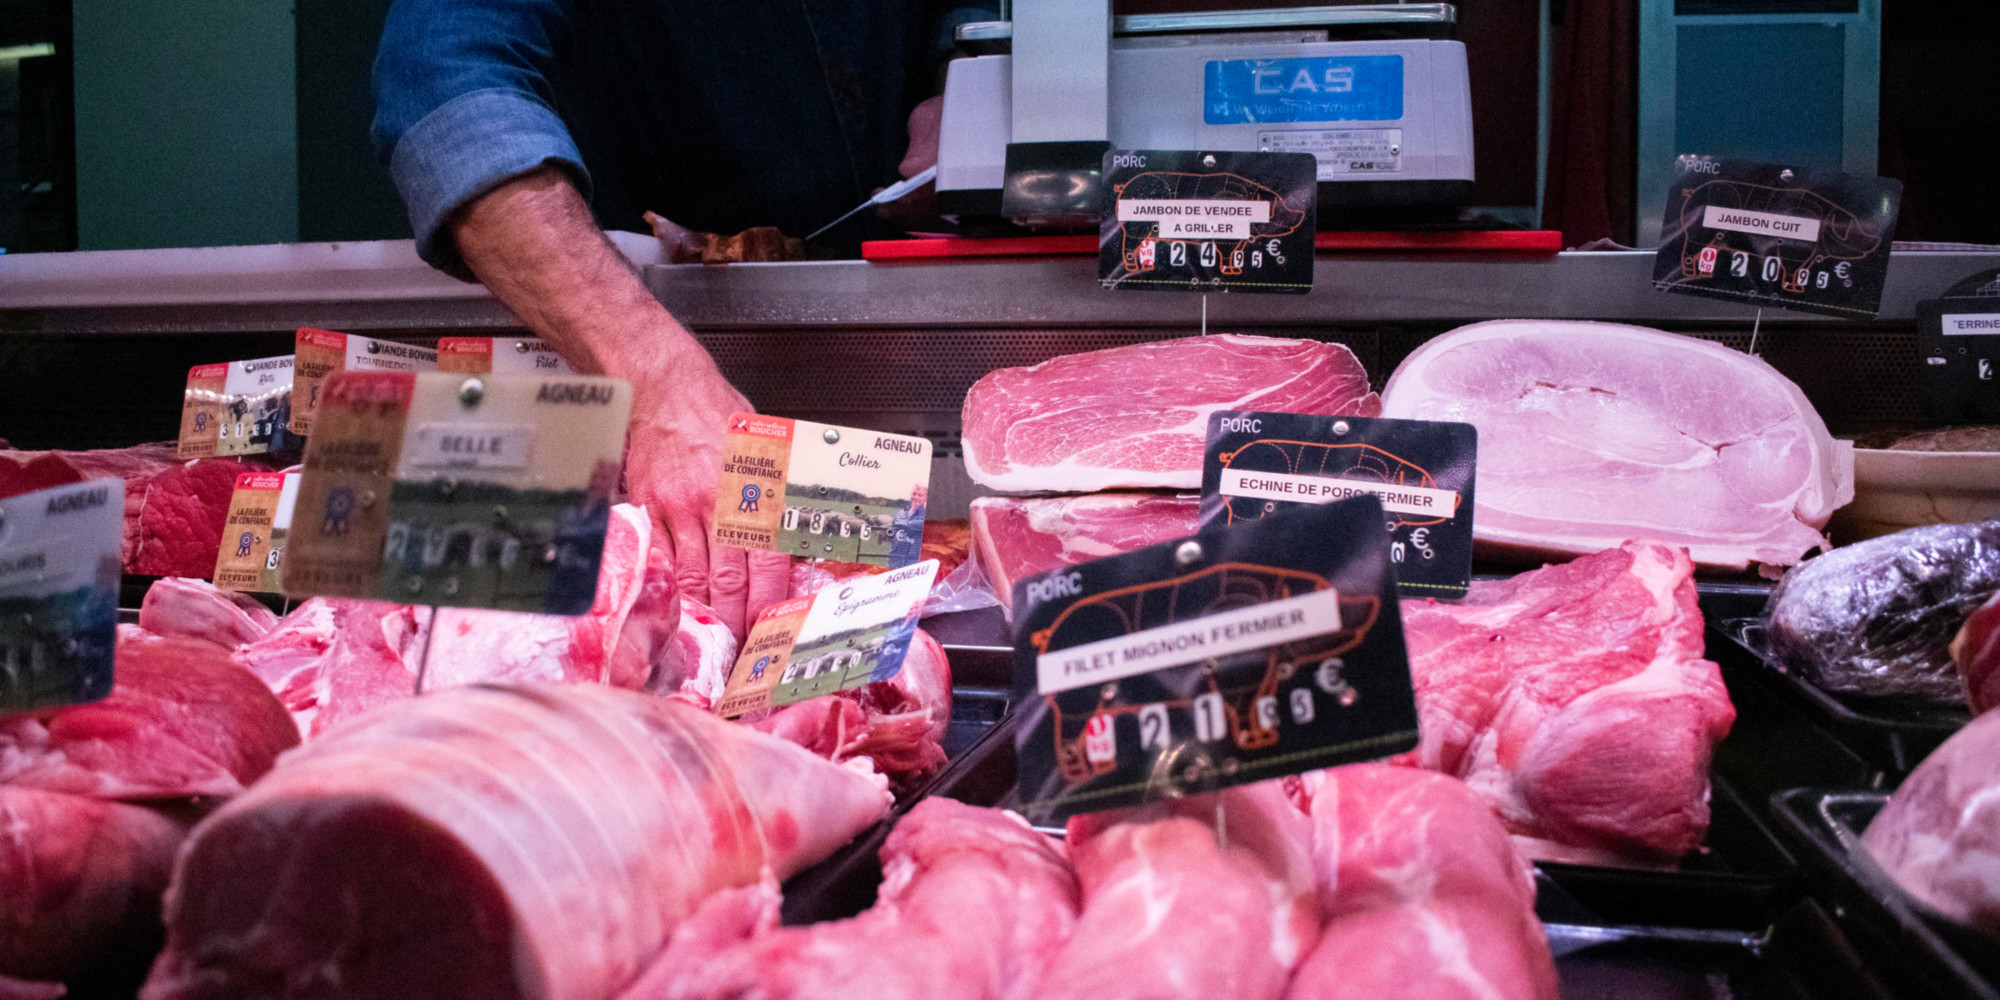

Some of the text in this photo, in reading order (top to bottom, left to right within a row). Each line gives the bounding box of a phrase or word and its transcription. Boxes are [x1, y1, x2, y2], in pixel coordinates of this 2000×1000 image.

[1254, 66, 1352, 94] CAS
[1323, 102, 1365, 113] WORLD
[1113, 155, 1146, 168] PORC
[1350, 161, 1374, 170] CAS
[1685, 159, 1720, 175] PORC
[1133, 206, 1252, 216] JAMBON DE VENDEE
[1174, 223, 1182, 232] A
[1718, 213, 1801, 233] JAMBON CUIT
[1266, 239, 1281, 257] €
[1834, 261, 1851, 279] €
[408, 348, 438, 363] BOVINE
[536, 355, 558, 369] Filet
[536, 383, 615, 405] AGNEAU
[749, 427, 787, 437] BOUCHER
[1220, 418, 1262, 433] PORC
[874, 437, 922, 455] AGNEAU
[732, 454, 743, 464] LA
[838, 452, 882, 470] Collier
[724, 464, 783, 480] DE CONFIANCE
[252, 481, 280, 489] BOUCHER
[1239, 478, 1293, 493] ECHINE
[1297, 484, 1317, 495] DE
[47, 487, 109, 515] AGNEAU
[236, 508, 245, 516] LA
[229, 516, 271, 526] DE CONFIANCE
[716, 528, 772, 543] ELEVEURS
[1409, 527, 1430, 549] €
[269, 551, 278, 567] 3
[884, 564, 930, 586] AGNEAU
[1026, 572, 1083, 603] PORC
[1064, 608, 1306, 677] FILET MIGNON FERMIER
